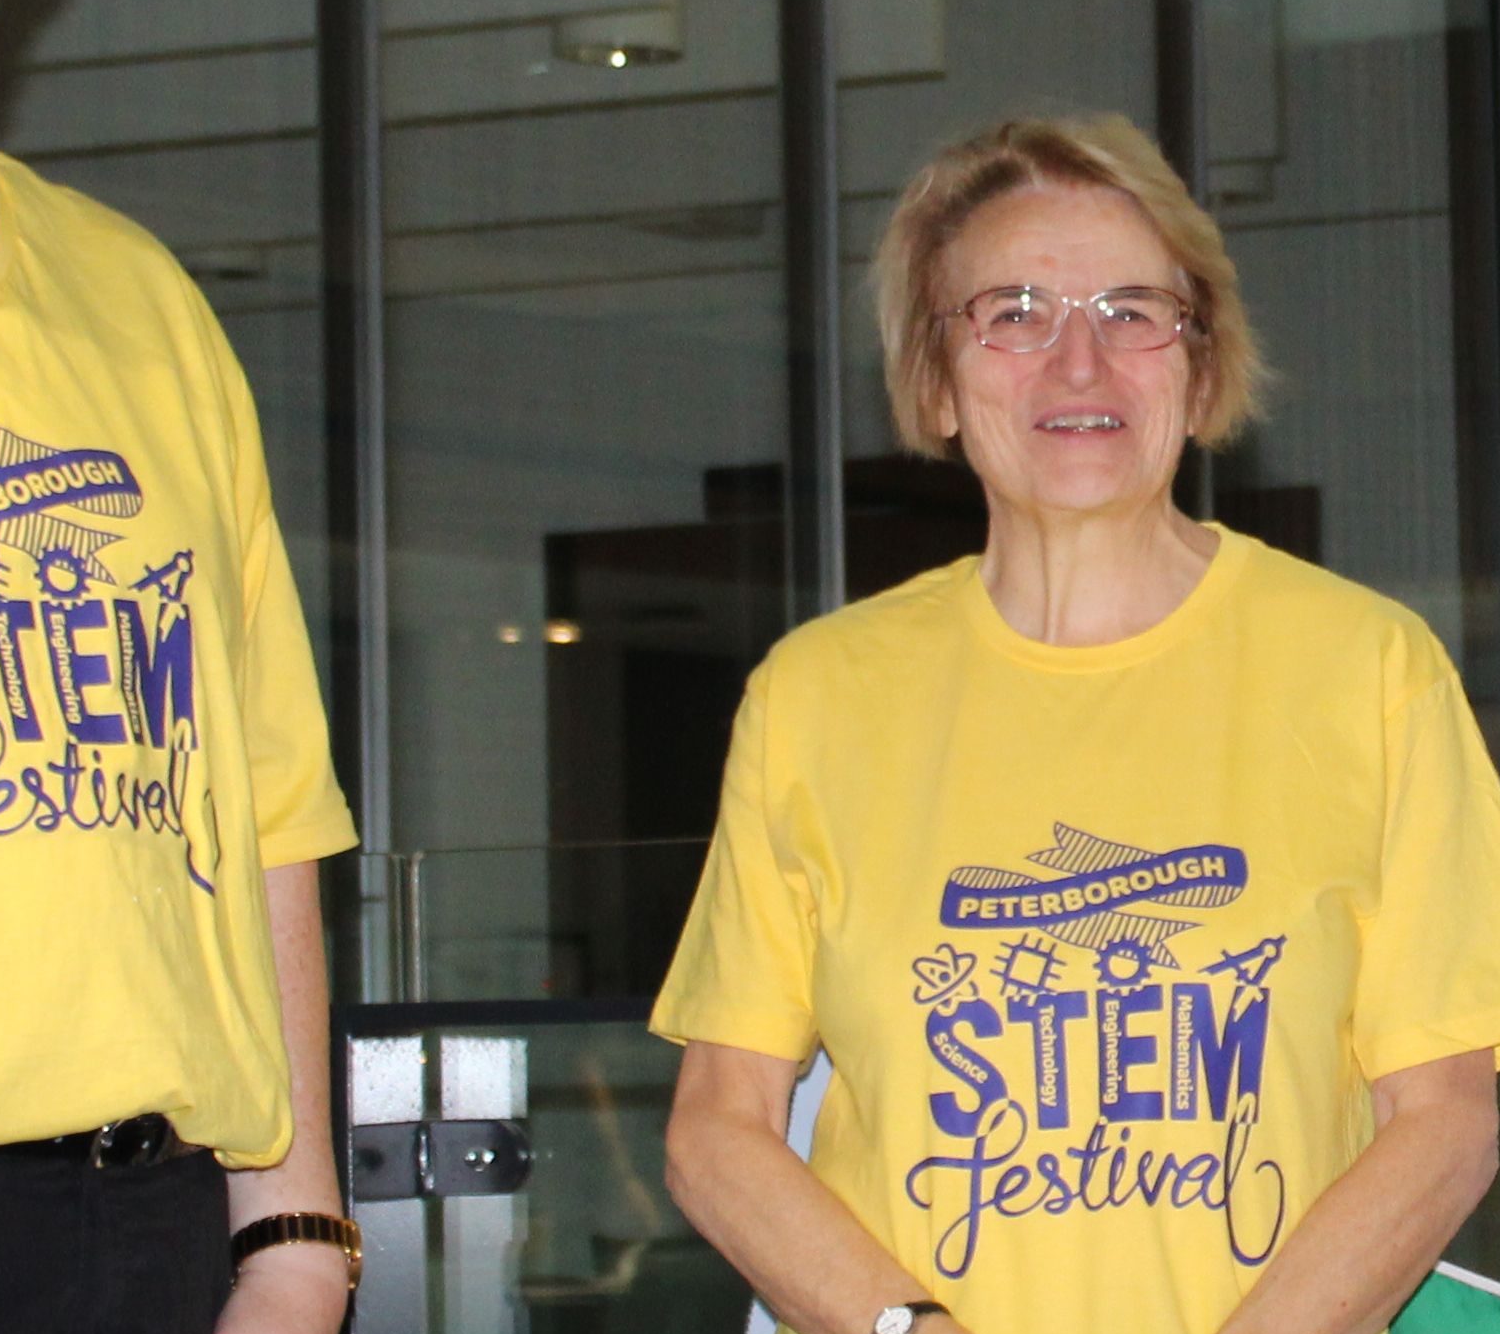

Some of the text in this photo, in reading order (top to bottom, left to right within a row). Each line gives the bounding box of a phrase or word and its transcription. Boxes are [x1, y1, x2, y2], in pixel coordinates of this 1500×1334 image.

[49, 612, 83, 725] Engineering
[956, 855, 1228, 920] PETERBOROUGH
[926, 982, 1271, 1139] STEM
[932, 1031, 989, 1086] Science
[1038, 1004, 1059, 1109] Technology
[1102, 999, 1121, 1105] Engineering
[1174, 993, 1195, 1111] Mathematics
